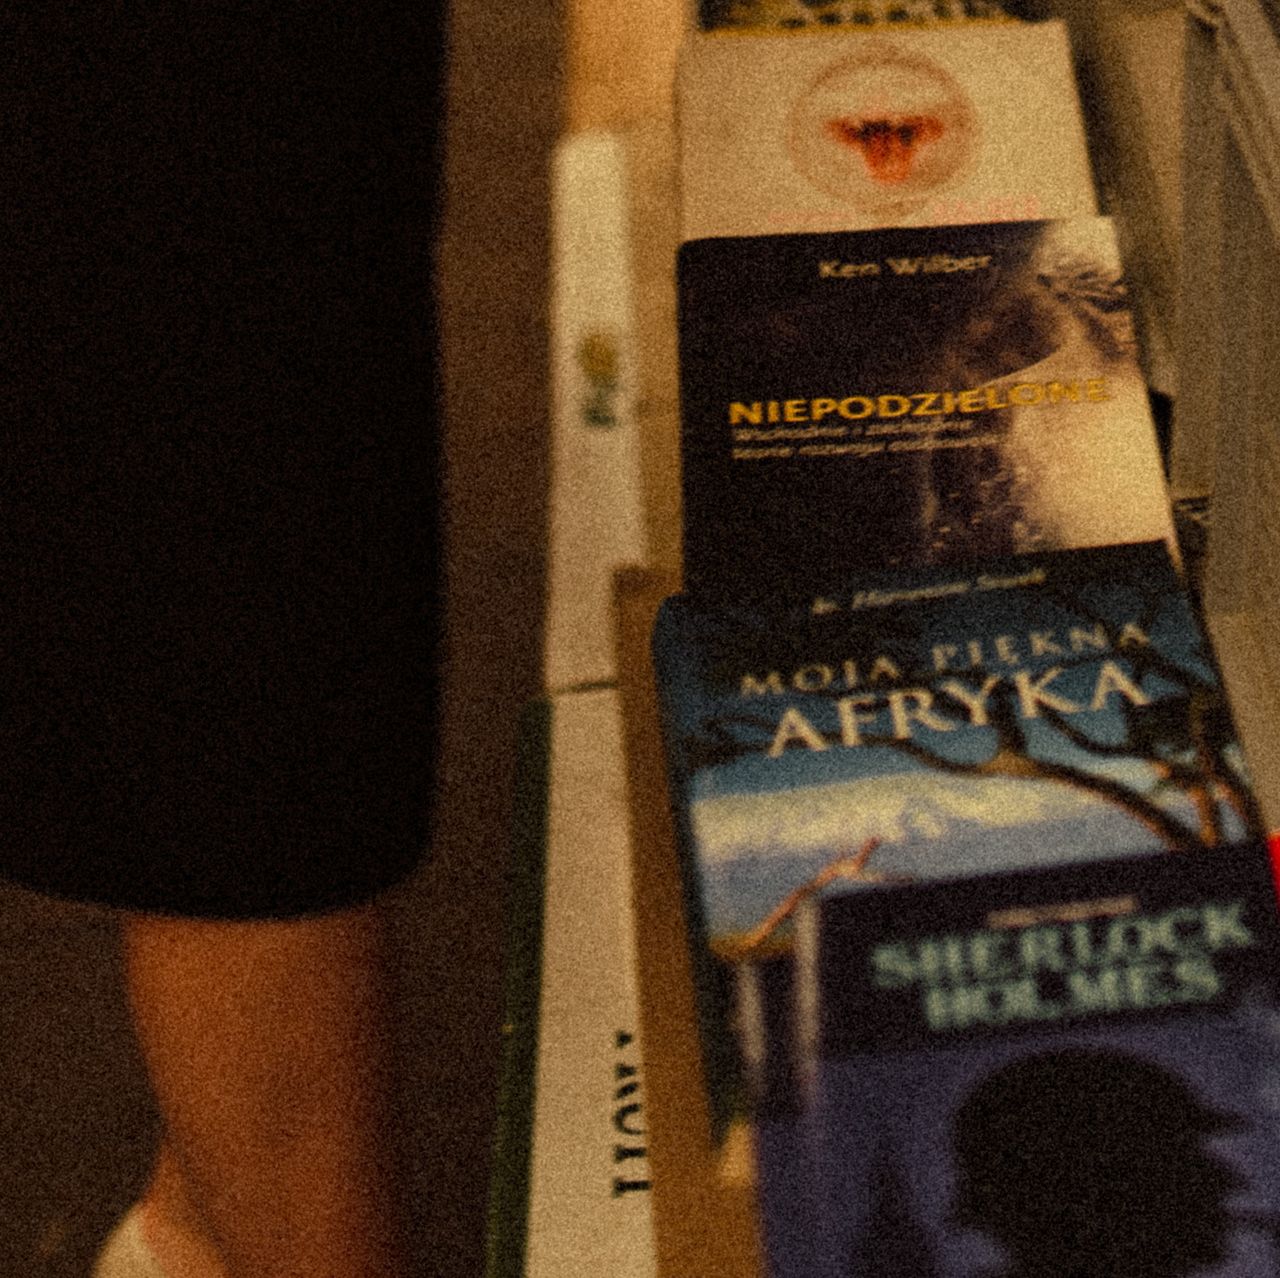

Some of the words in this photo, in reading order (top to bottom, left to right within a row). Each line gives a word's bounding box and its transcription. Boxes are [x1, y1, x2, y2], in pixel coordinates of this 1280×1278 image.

[818, 260, 881, 278] Ken
[887, 252, 993, 276] Wilber
[729, 379, 1112, 425] NIEPODZIELONE
[931, 622, 1152, 672] PIĘKNA
[765, 660, 1153, 759] AFRYKA
[871, 898, 1256, 988] SHERLOCK
[923, 957, 1224, 1032] HOLMES
